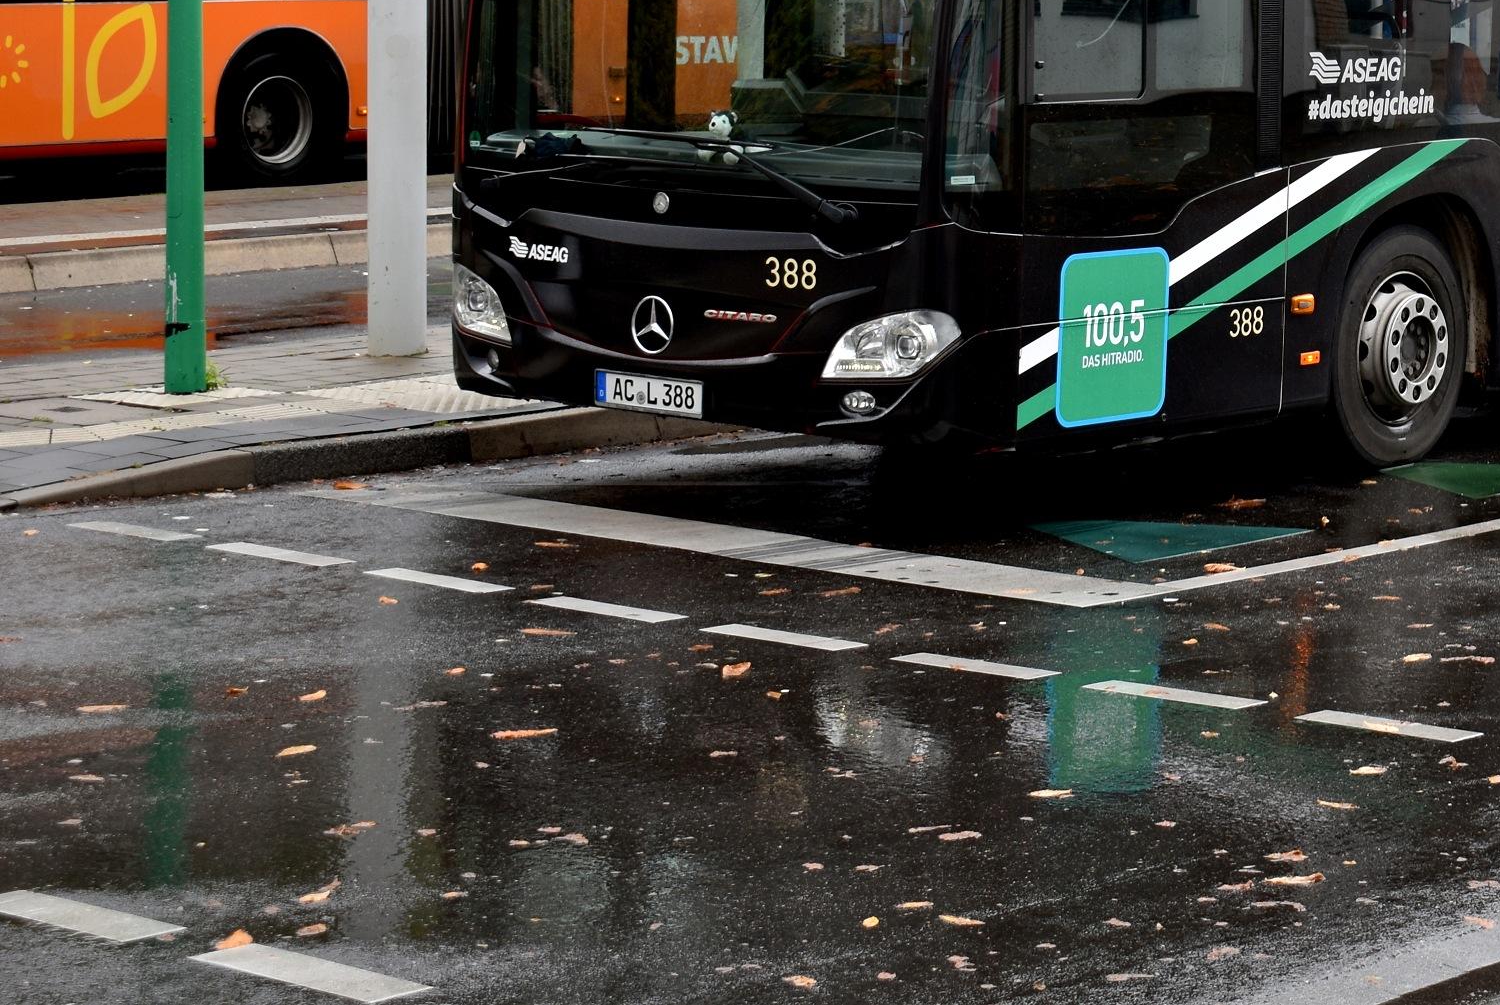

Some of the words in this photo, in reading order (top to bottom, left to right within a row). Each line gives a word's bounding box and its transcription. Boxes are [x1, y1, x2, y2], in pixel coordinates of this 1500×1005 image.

[1341, 57, 1401, 83] ASEAG
[1308, 88, 1434, 122] #dasteigichein
[528, 243, 568, 263] ASEAG
[765, 256, 817, 290] 388
[704, 309, 777, 323] CITARO
[1083, 299, 1145, 347] 100,5
[1229, 306, 1264, 338] 388
[1082, 353, 1100, 369] DAS
[1101, 349, 1144, 366] HITRADIO.
[613, 378, 634, 401] AC
[647, 381, 657, 405] L
[662, 383, 695, 409] 388
